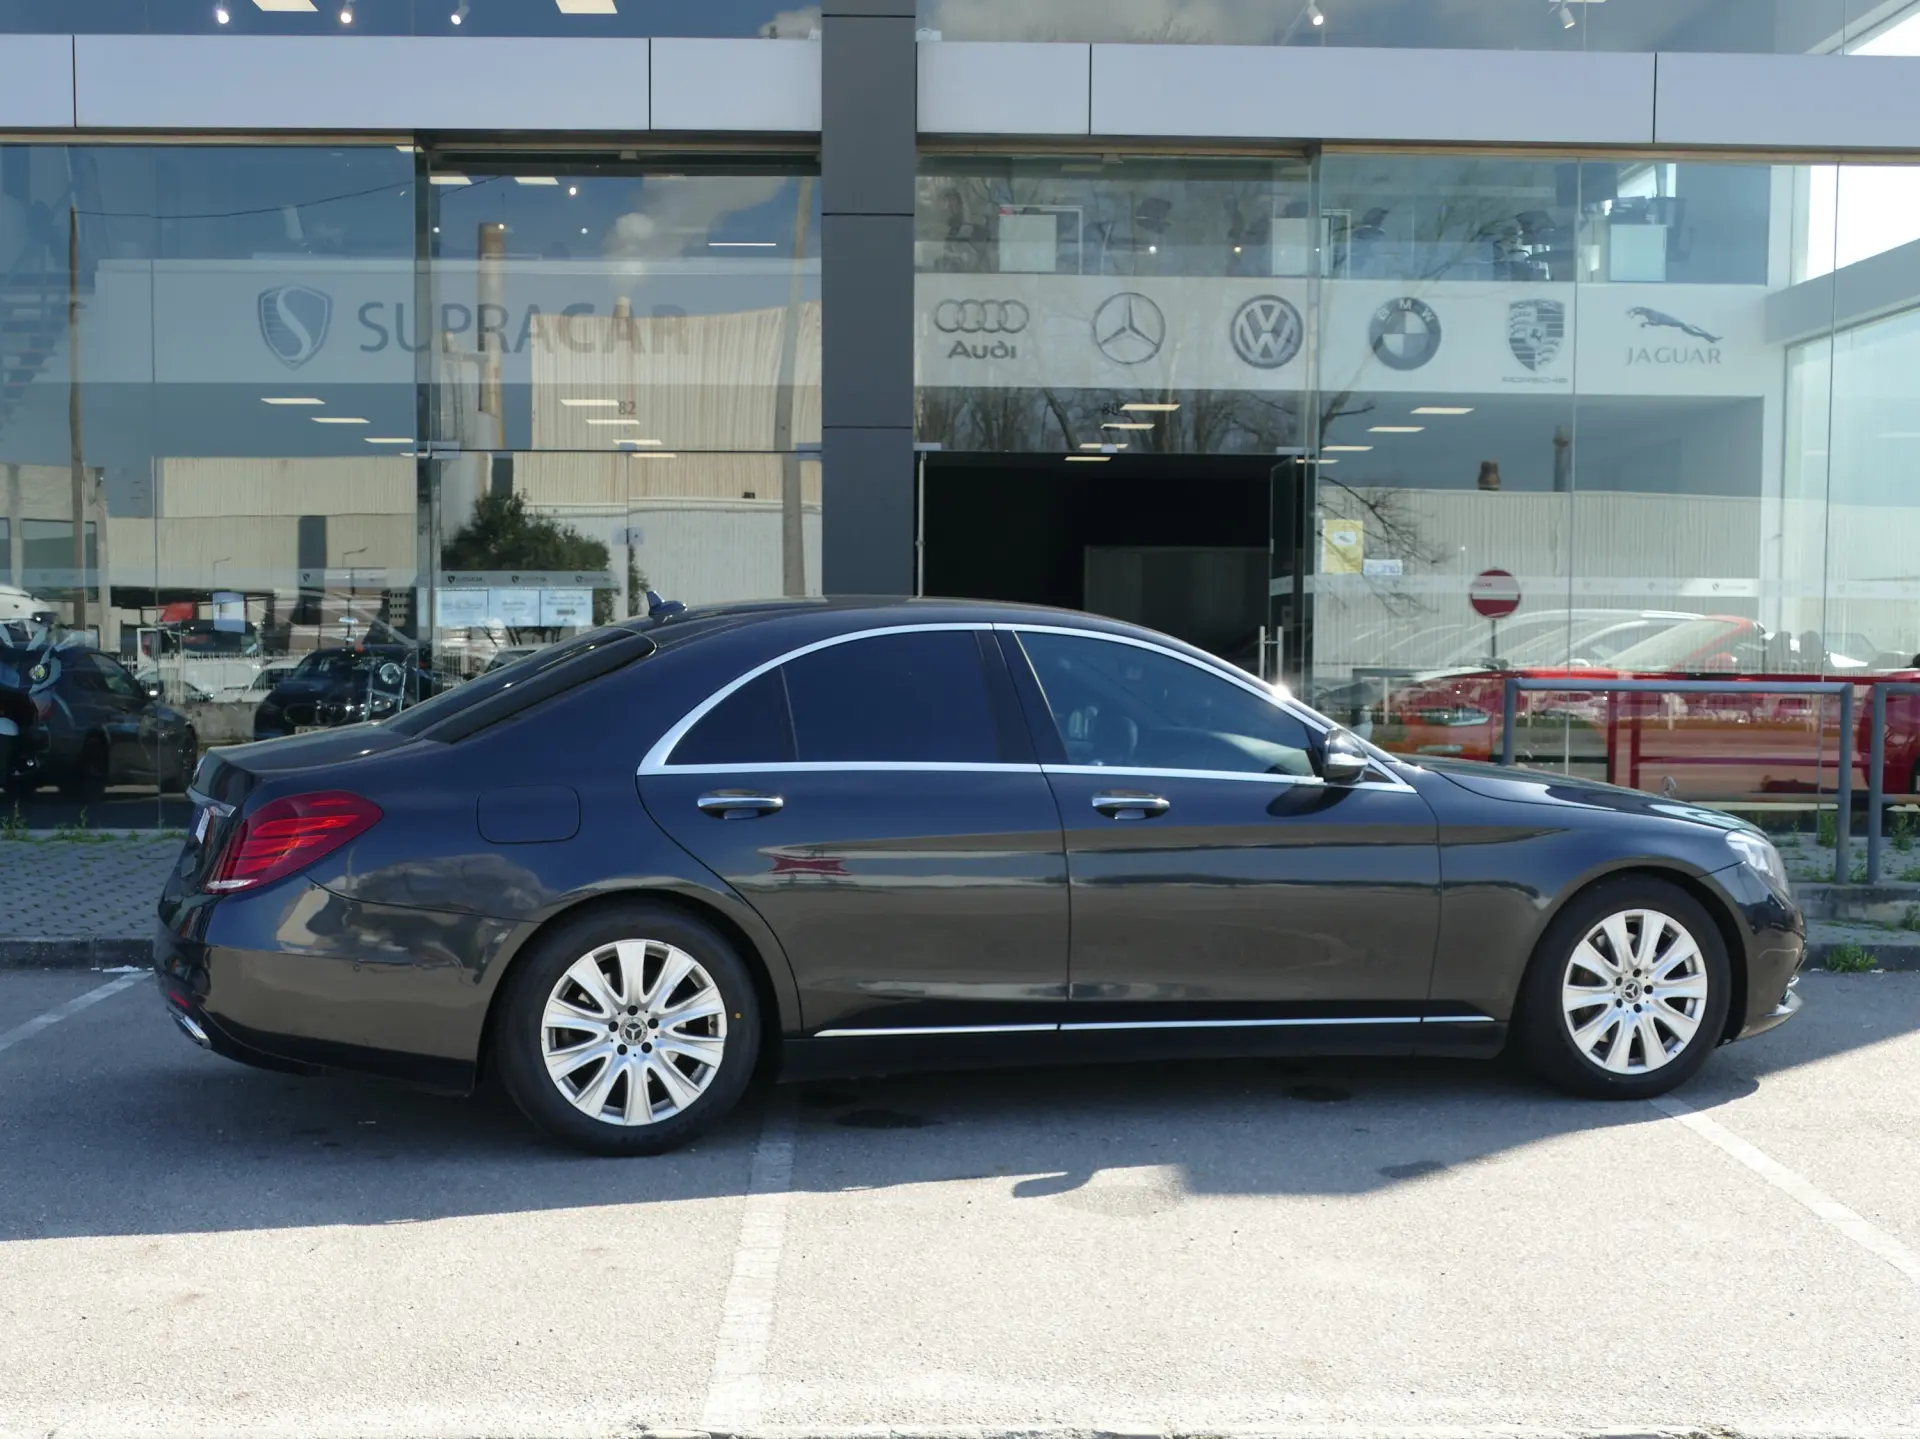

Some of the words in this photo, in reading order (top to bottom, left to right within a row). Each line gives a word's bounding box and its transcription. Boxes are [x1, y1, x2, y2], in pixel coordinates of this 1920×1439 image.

[357, 301, 690, 355] SUPRACAR
[947, 340, 1017, 359] Audi
[1626, 347, 1721, 366] JAGUAR
[618, 400, 637, 415] 82
